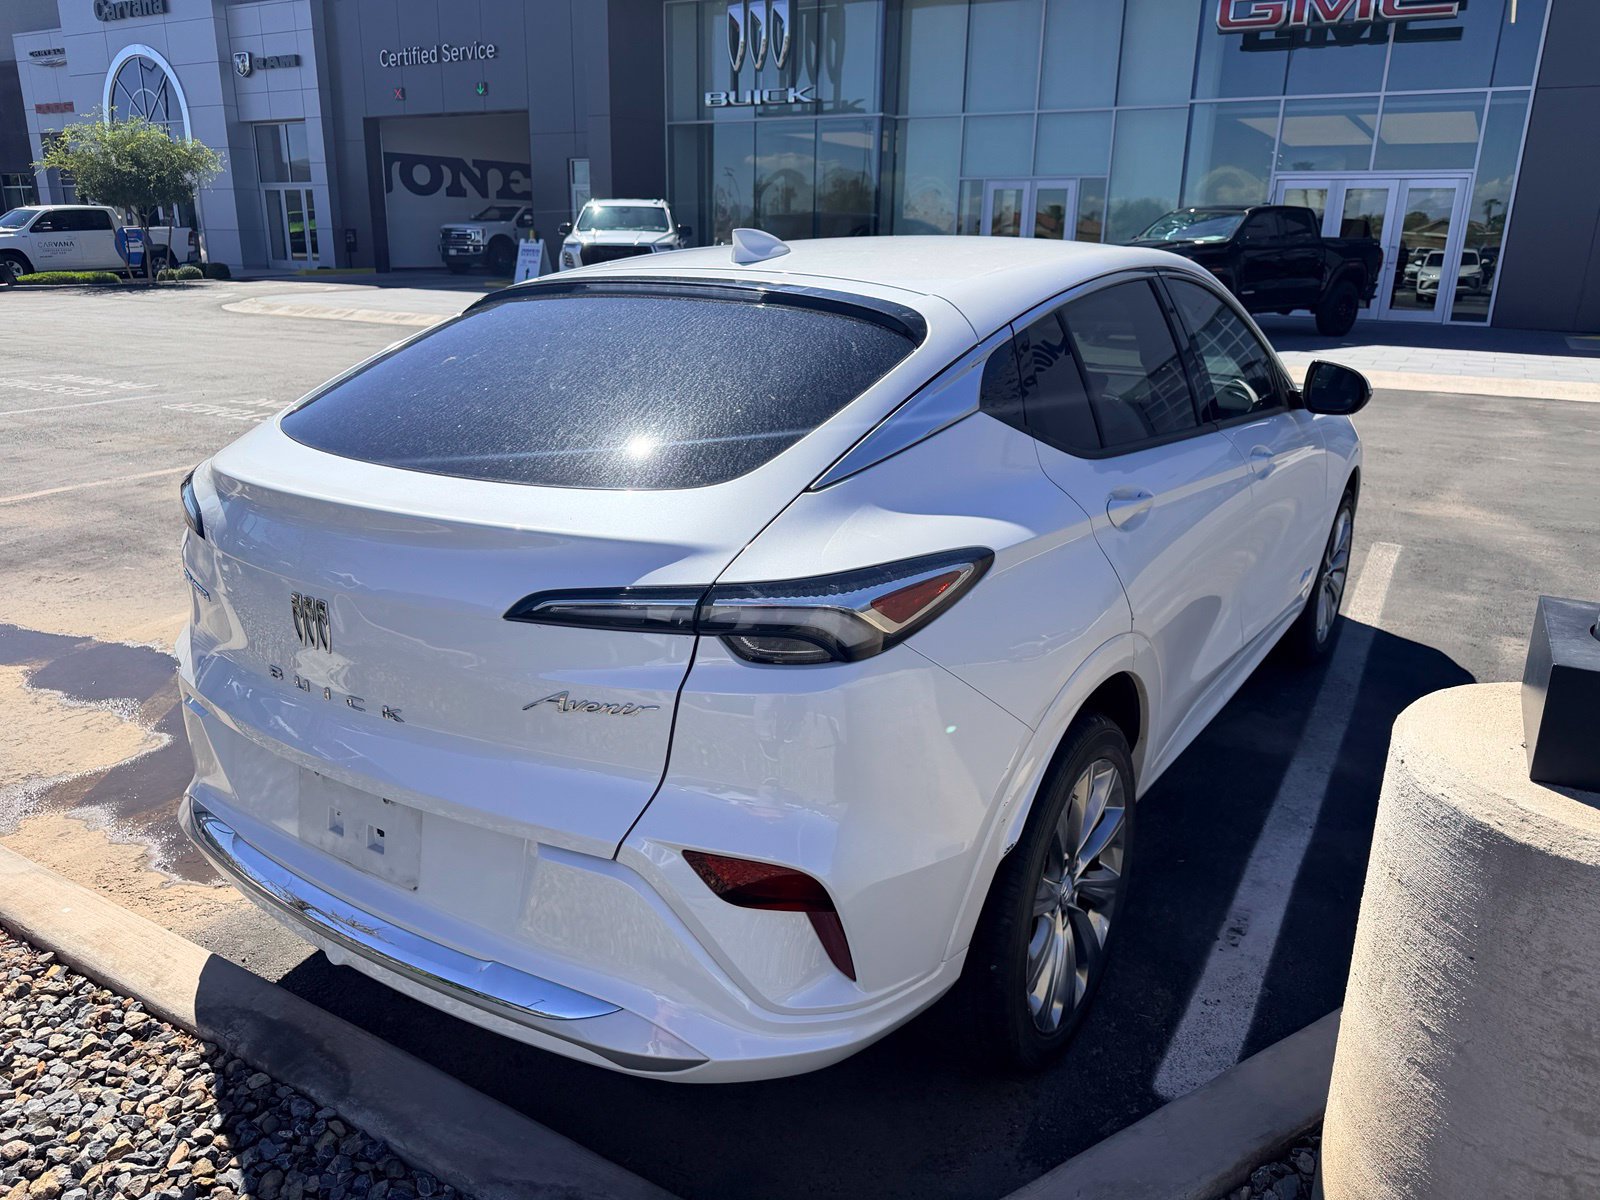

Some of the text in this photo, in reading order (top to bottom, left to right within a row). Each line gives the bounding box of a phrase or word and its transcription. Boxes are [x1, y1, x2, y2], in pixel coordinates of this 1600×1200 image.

[94, 0, 167, 21] Carvana
[254, 55, 300, 70] RAM
[379, 41, 496, 68] Certified Service
[705, 85, 815, 107] BUICK
[269, 664, 405, 723] BUICK
[522, 690, 660, 714] Avenir
